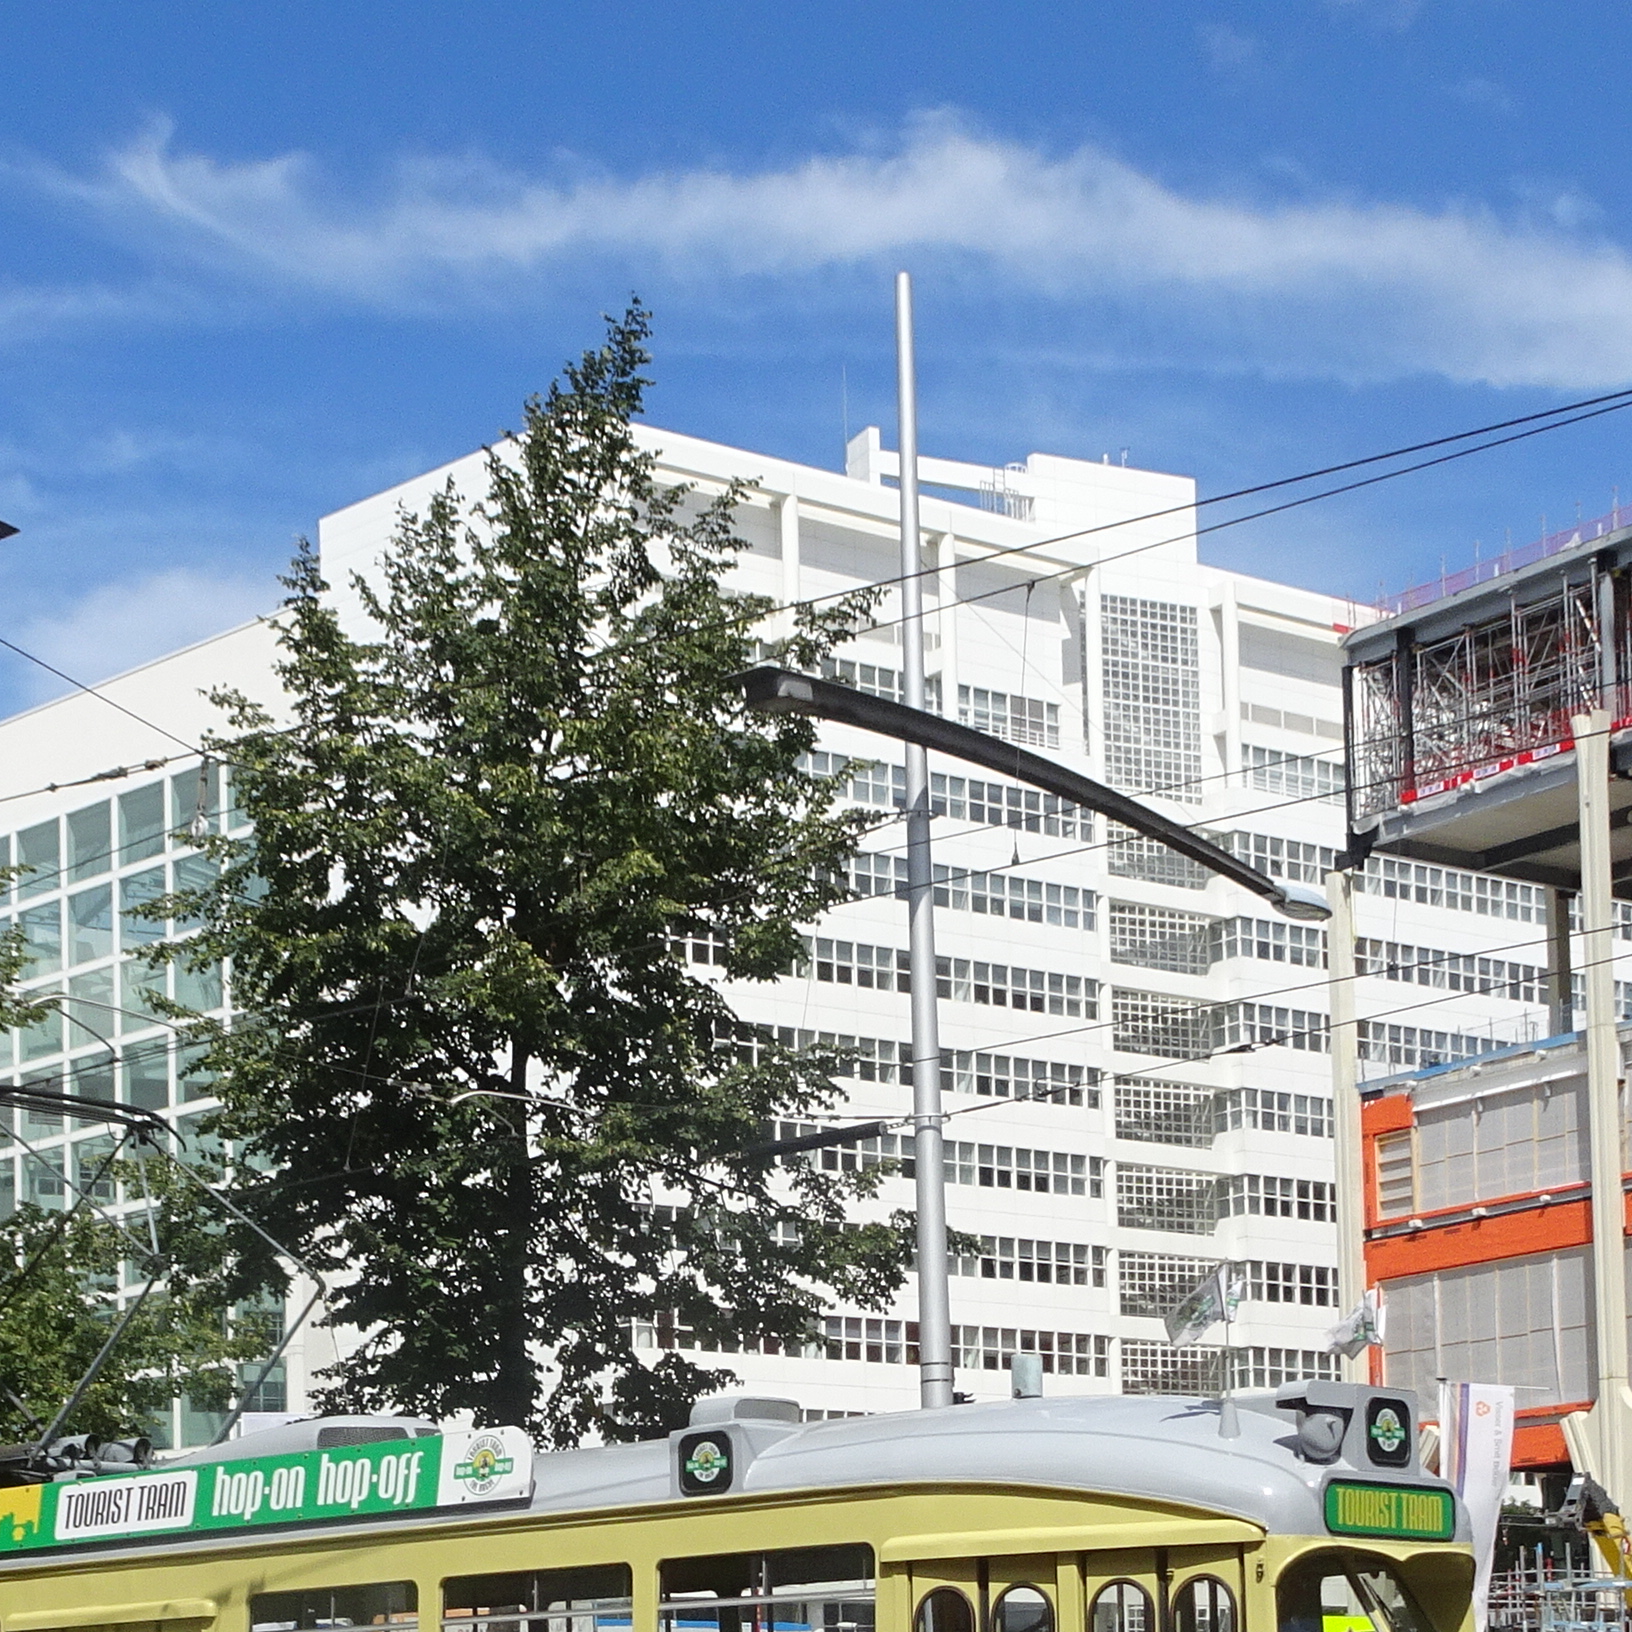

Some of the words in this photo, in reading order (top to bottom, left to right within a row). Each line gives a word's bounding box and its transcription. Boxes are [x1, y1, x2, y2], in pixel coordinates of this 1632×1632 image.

[65, 1486, 132, 1529] TOURIST
[137, 1481, 187, 1521] TRAM
[1337, 1488, 1398, 1528] TOURIST
[1401, 1493, 1443, 1531] TRAM
